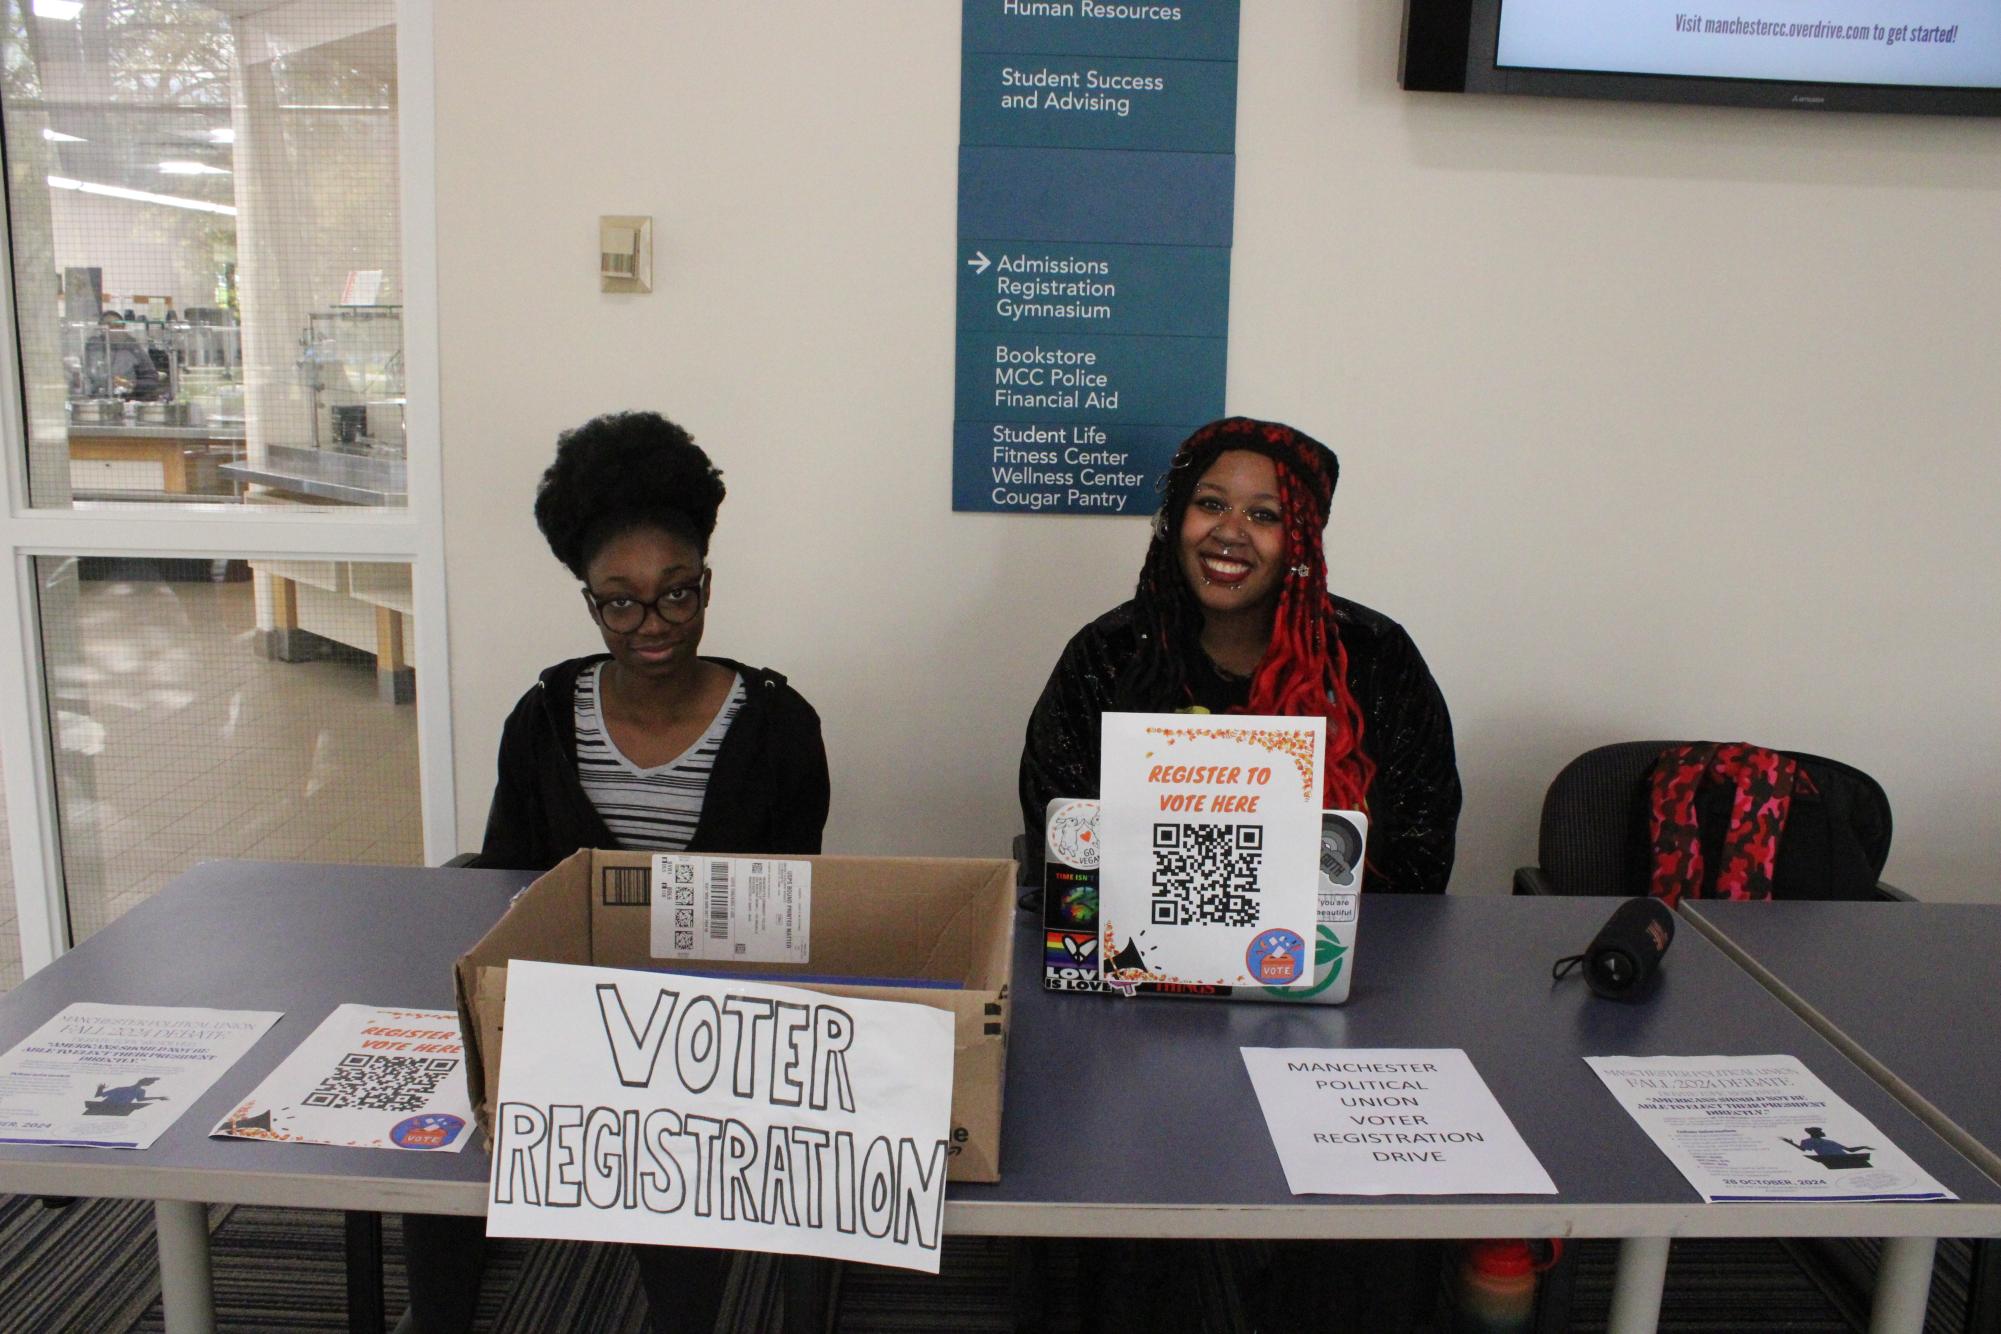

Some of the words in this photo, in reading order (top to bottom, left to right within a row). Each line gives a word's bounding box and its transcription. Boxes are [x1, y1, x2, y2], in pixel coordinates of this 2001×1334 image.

[1003, 0, 1074, 17] Human
[1081, 0, 1182, 20] Resources
[1675, 14, 1701, 33] Visit
[1704, 17, 1870, 41] manchestercc.overdrive.com
[1873, 23, 1885, 40] to
[1887, 26, 1908, 45] get
[1909, 25, 1958, 43] started!
[1001, 68, 1079, 88] Student
[1087, 70, 1164, 90] Success
[1001, 91, 1038, 109] and
[1044, 92, 1130, 116] Advising
[997, 255, 1109, 275] Admissions
[997, 277, 1115, 298] Registration
[996, 299, 1111, 321] Gymnasium
[996, 346, 1096, 365] Bookstore
[995, 368, 1044, 386] MCC
[1051, 369, 1107, 387] Police
[995, 390, 1079, 408] Financial
[1085, 391, 1118, 409] Aid
[993, 425, 1066, 443] Student
[1073, 426, 1107, 444] Life
[993, 447, 1058, 464] Fitness
[1064, 448, 1128, 465] Center
[992, 467, 1073, 485] Wellness
[1080, 469, 1144, 487] Center
[992, 488, 1061, 509] Cougar
[1068, 489, 1127, 511] Pantry
[1148, 765, 1241, 784] REGISTER
[1246, 767, 1271, 785] TO
[1160, 794, 1207, 812] VOTE
[1211, 795, 1260, 813] HERE
[1084, 848, 1095, 857] GO
[1056, 873, 1074, 881] TIME
[1047, 966, 1097, 981] LOV
[1263, 967, 1291, 975] VOTE
[1046, 978, 1061, 989] IS
[1067, 980, 1111, 991] LOVE
[361, 1027, 456, 1040] REGISTER
[361, 1040, 412, 1051] VOTE
[413, 1043, 465, 1053] HERE
[595, 983, 856, 1113] VOTER
[1287, 1062, 1439, 1073] MANCHESTER
[1316, 1080, 1429, 1090] POLITICAL
[1713, 1077, 1797, 1087] DEBATE
[1340, 1096, 1419, 1107] UNION
[1350, 1115, 1429, 1126] VOTER
[1313, 1132, 1485, 1144] REGISTRATION
[1372, 1151, 1447, 1162] DRIVE
[494, 1101, 949, 1250] REGISTRATION
